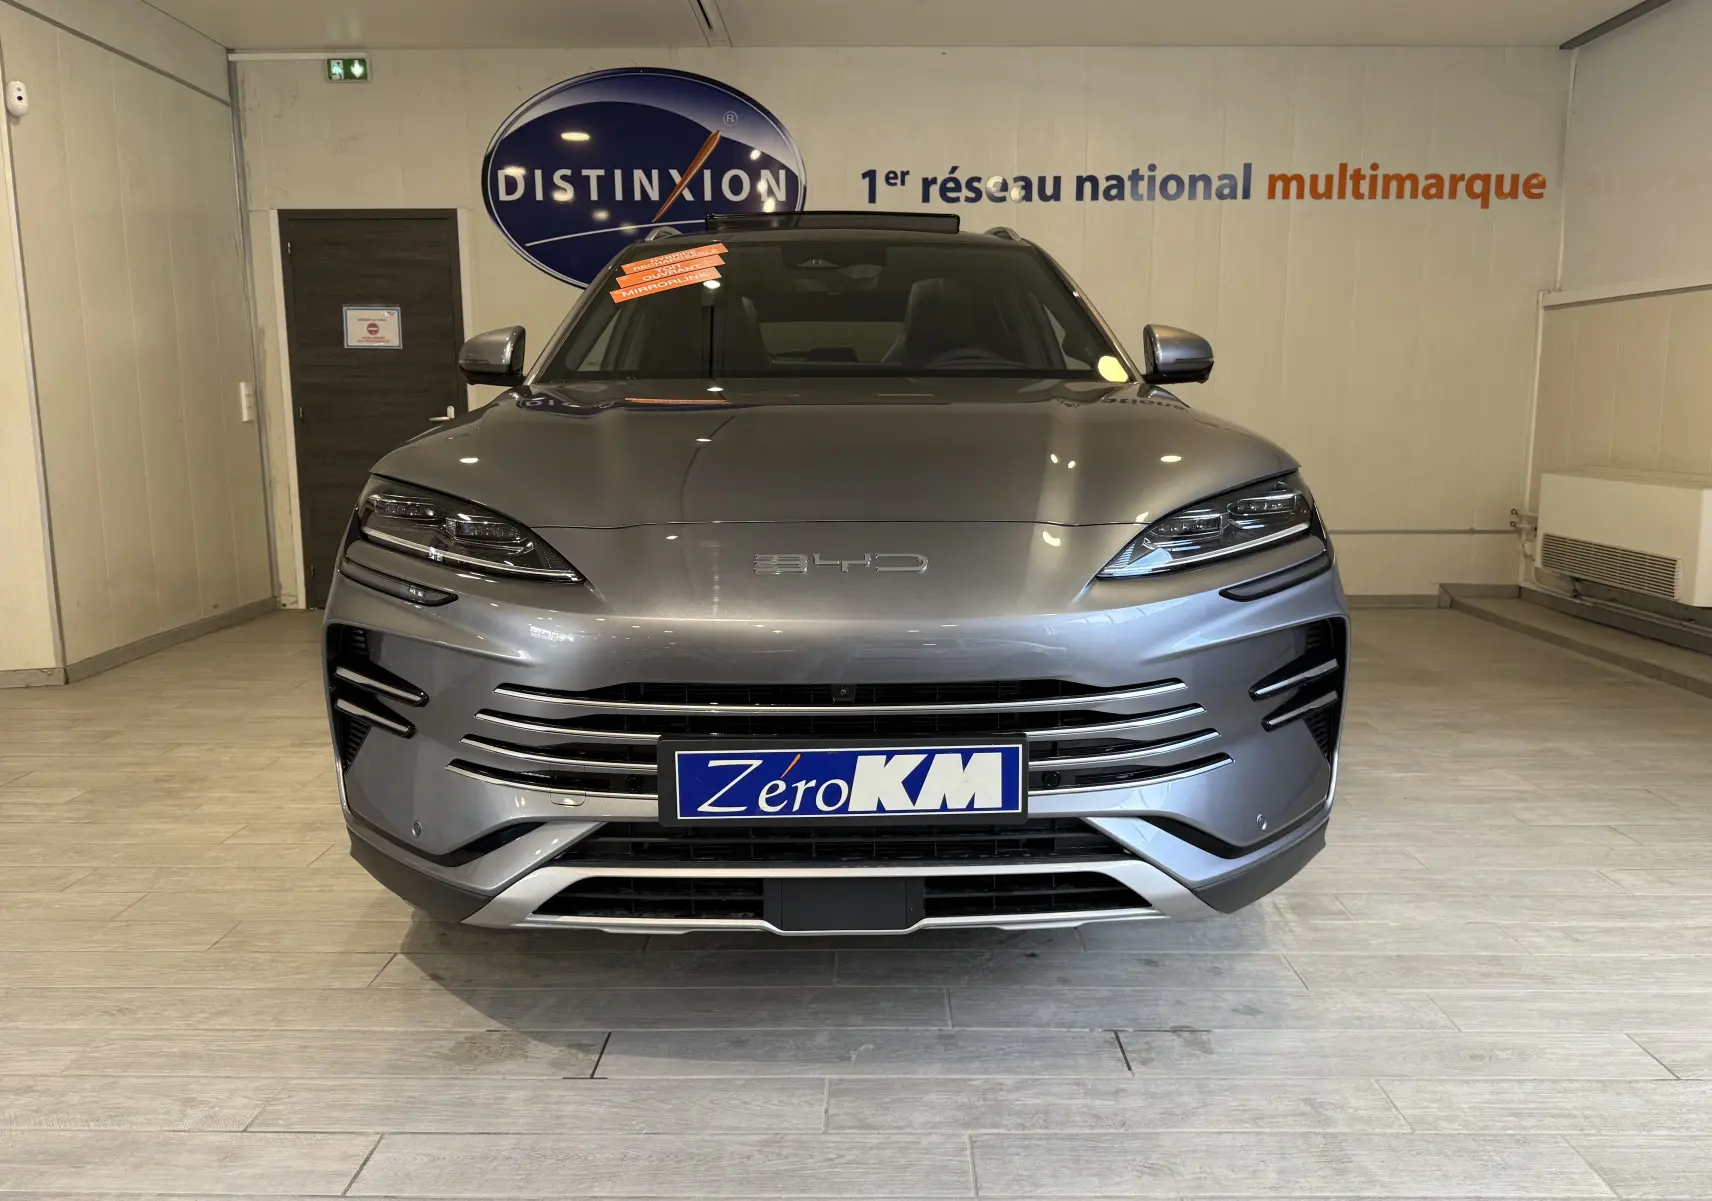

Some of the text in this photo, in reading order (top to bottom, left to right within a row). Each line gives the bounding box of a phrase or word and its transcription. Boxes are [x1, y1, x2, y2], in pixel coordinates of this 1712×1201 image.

[497, 168, 787, 202] DISTINXION
[921, 166, 1062, 203] réseau
[1075, 163, 1253, 202] national
[1267, 162, 1547, 210] multimarque
[642, 264, 701, 281] OUVRANT
[656, 264, 682, 273] TOIT
[621, 271, 712, 298] MIRRORLINK
[754, 553, 929, 575] BYD
